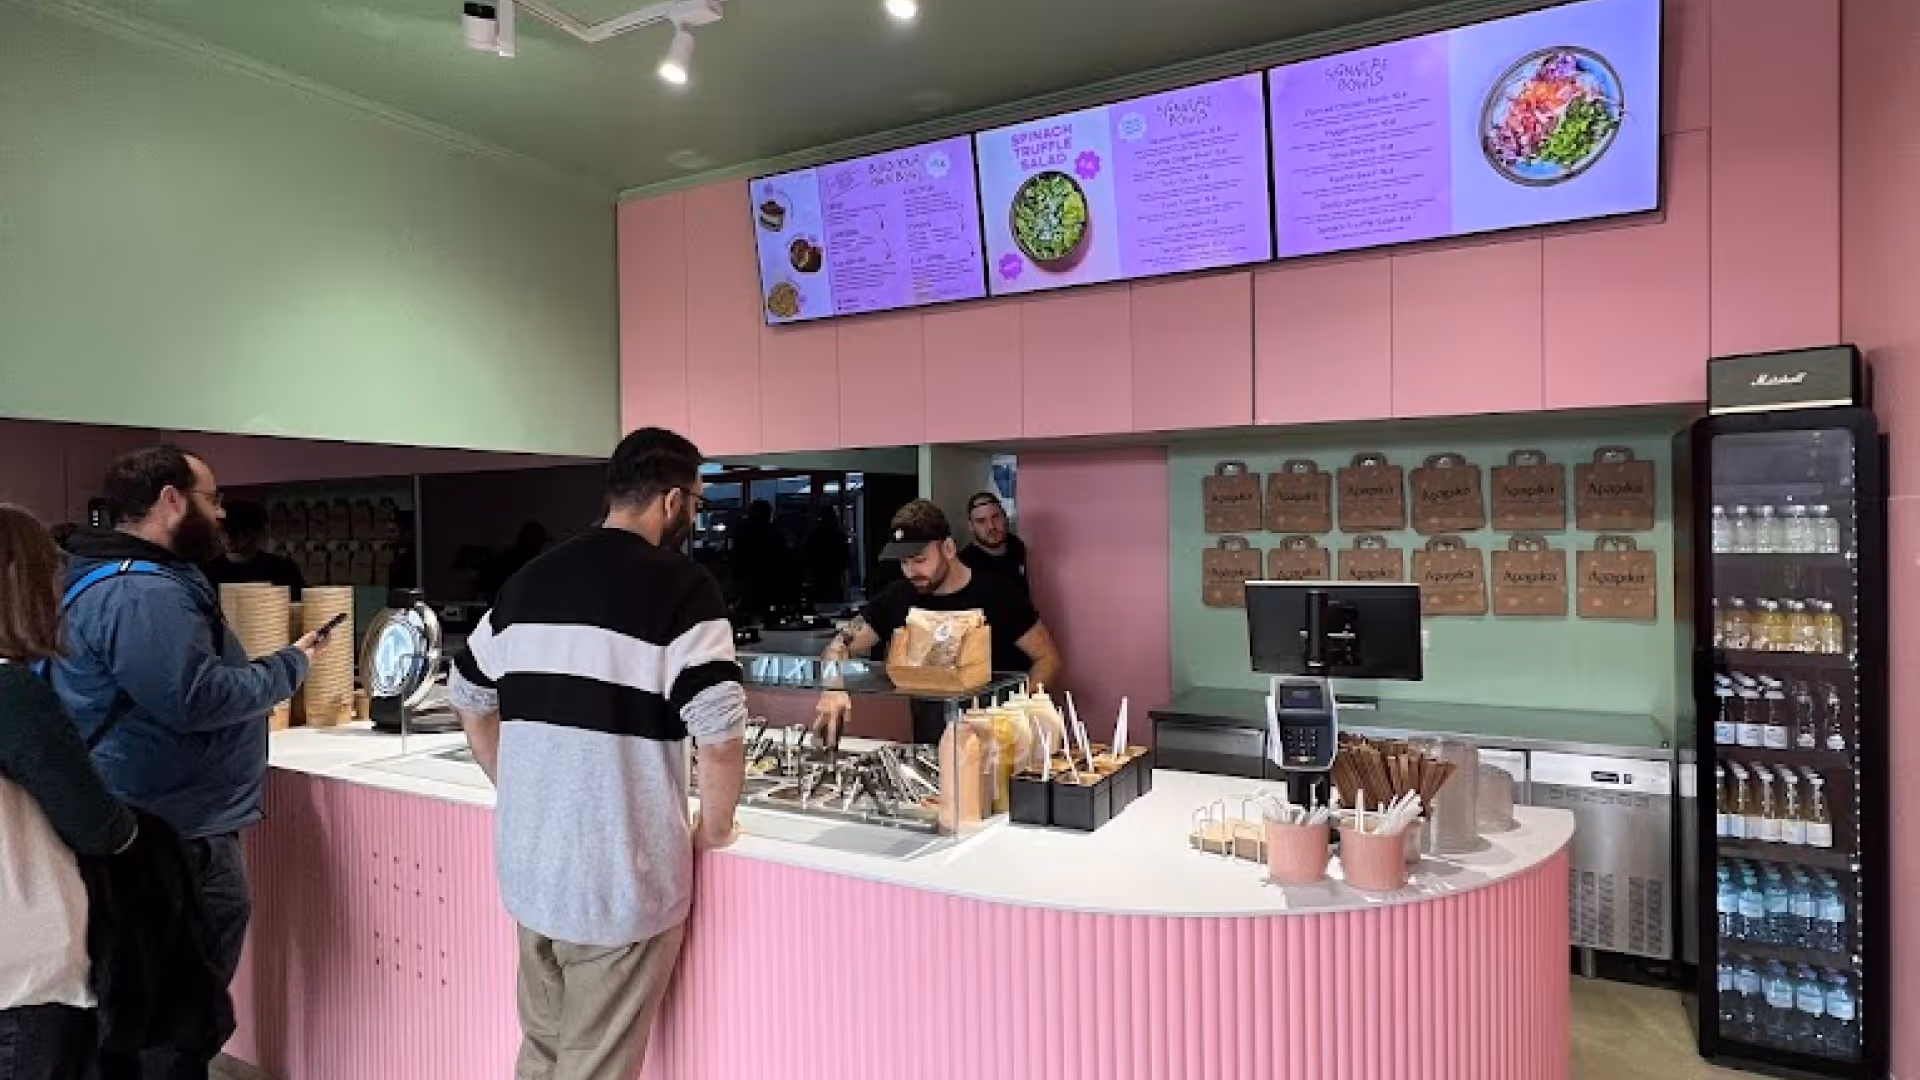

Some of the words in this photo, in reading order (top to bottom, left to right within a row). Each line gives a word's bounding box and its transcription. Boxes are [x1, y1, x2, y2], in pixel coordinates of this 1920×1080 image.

[1010, 123, 1073, 149] SPINACH
[1013, 137, 1073, 160] TRUFFLE
[1020, 152, 1067, 171] SALAD
[1421, 486, 1471, 502] Apapika
[1502, 483, 1555, 498] Apapika
[1588, 480, 1643, 497] Apapika
[1424, 568, 1474, 583] Apapika
[1503, 569, 1558, 583] Apapika
[1588, 569, 1645, 586] Apapika
